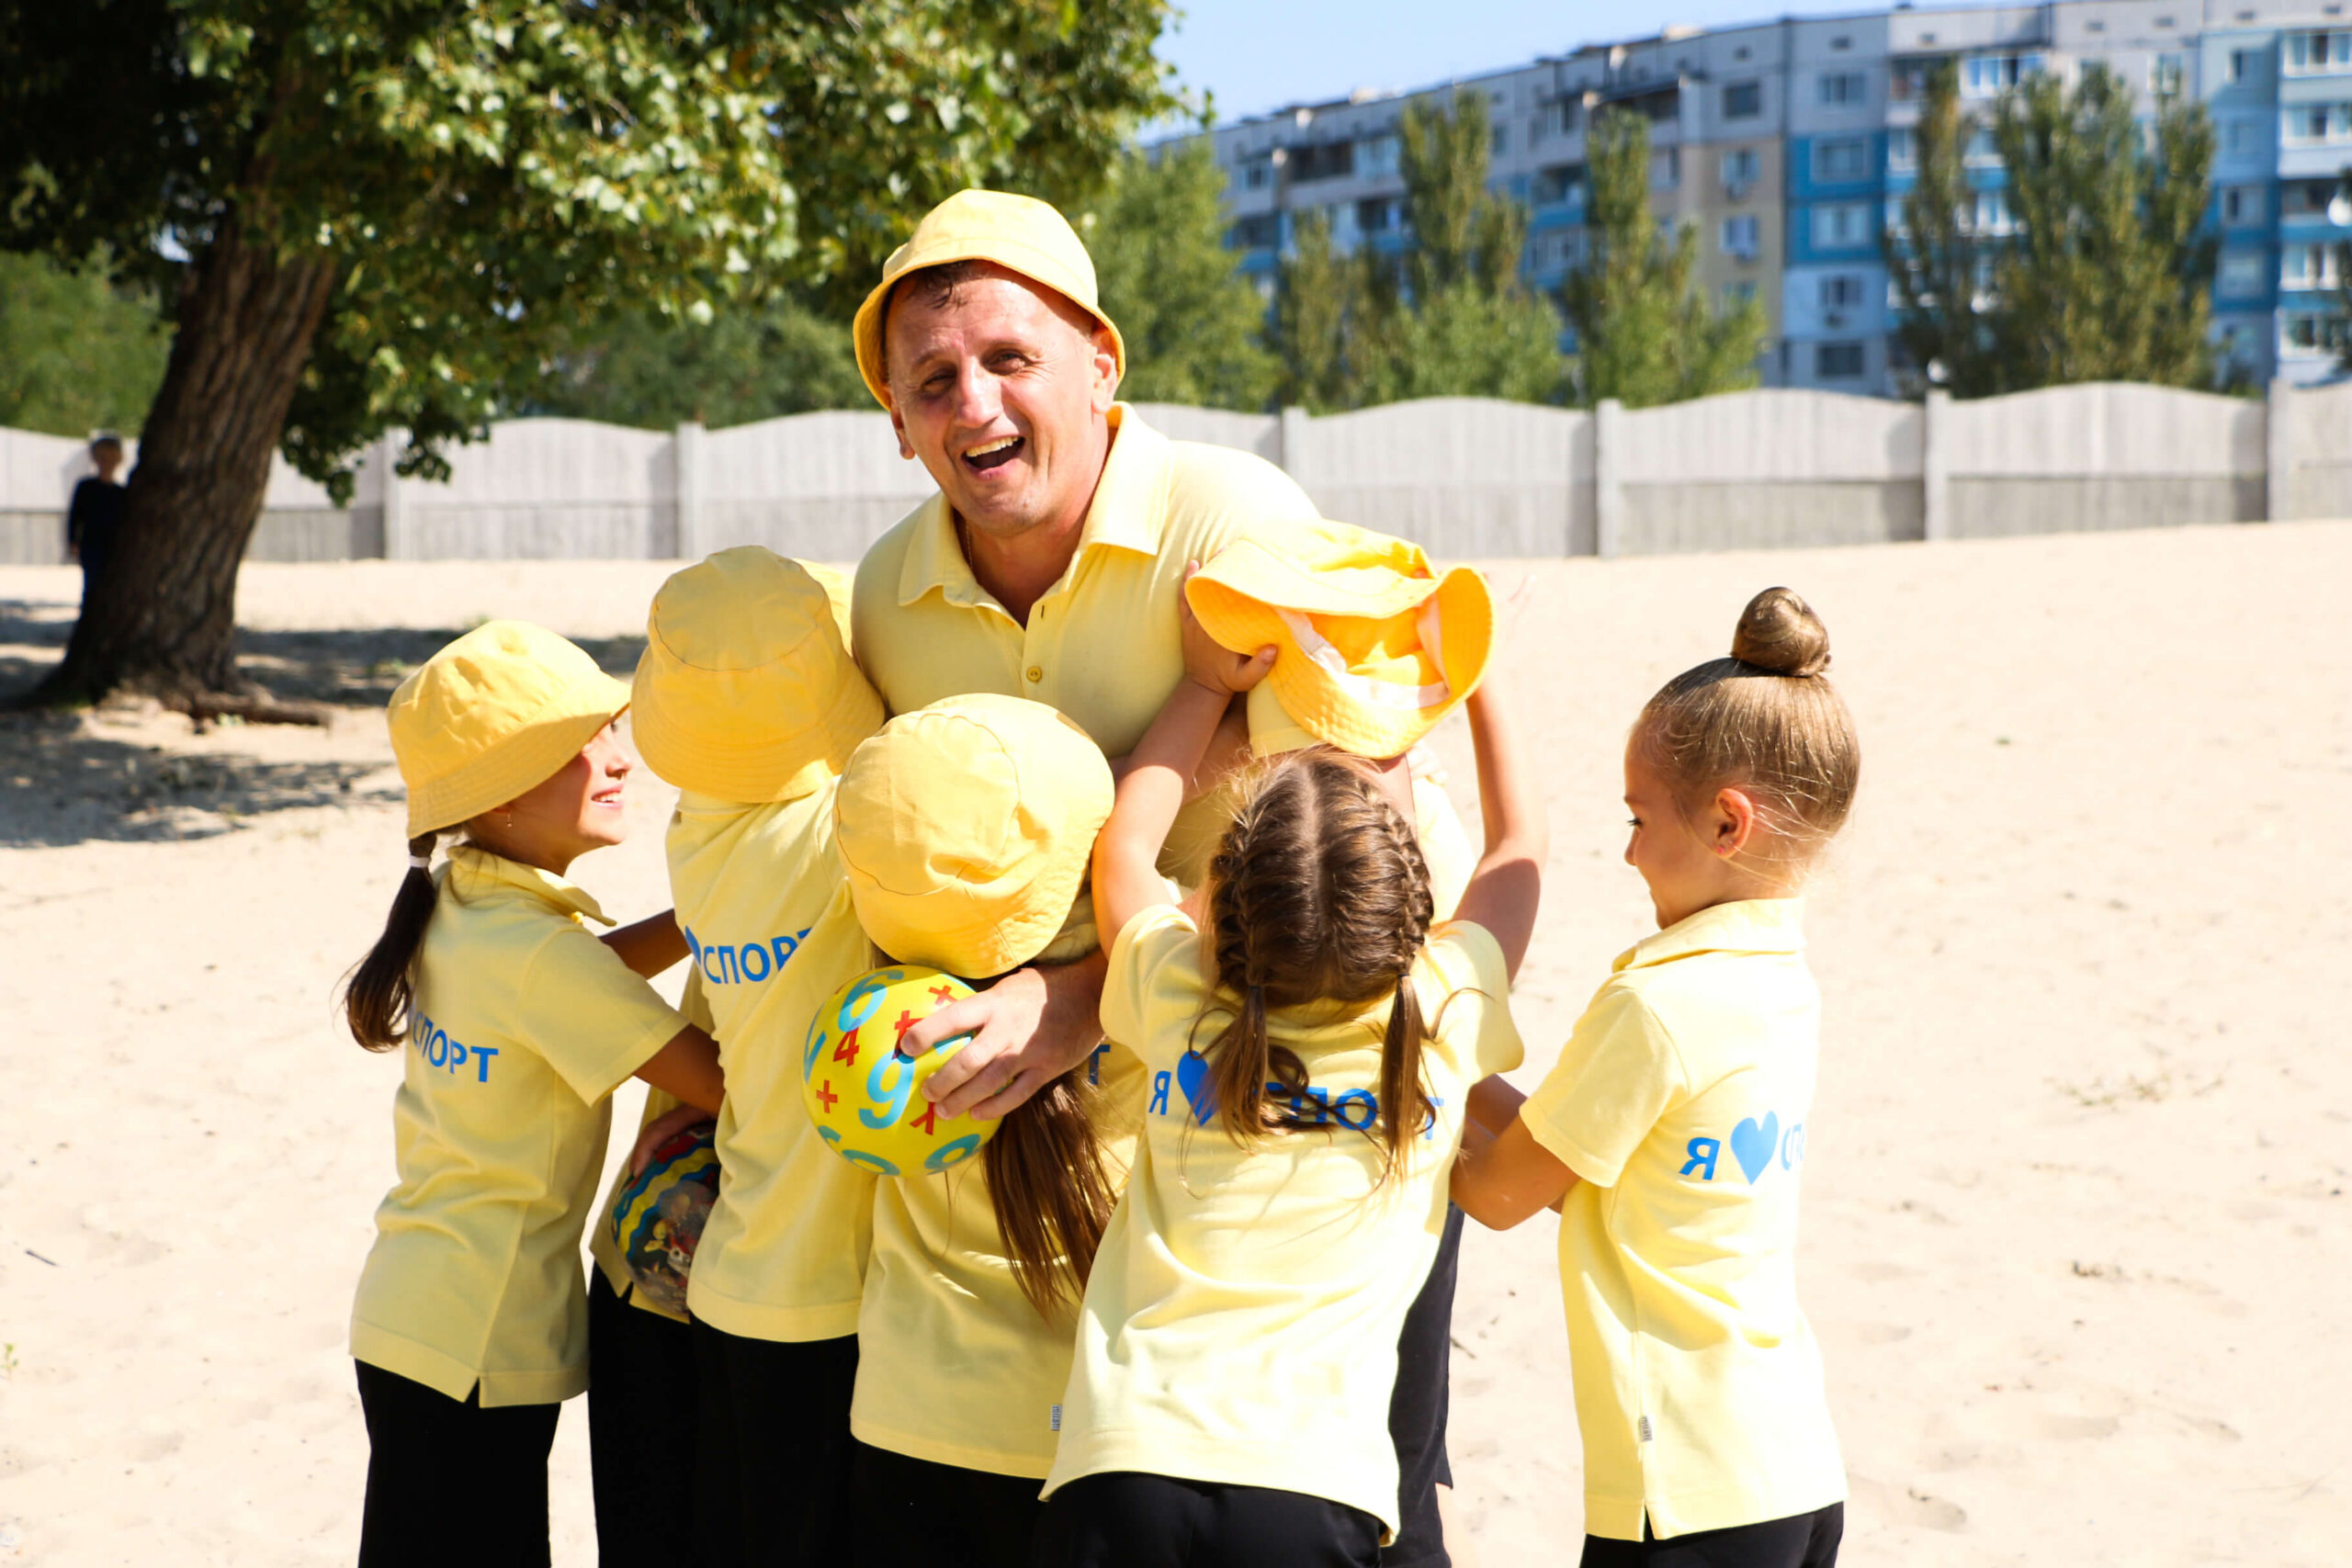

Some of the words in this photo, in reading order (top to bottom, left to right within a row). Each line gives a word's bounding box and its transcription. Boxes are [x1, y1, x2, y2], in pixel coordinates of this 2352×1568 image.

[838, 970, 905, 1032] 6
[832, 1018, 860, 1067] 4
[858, 1050, 915, 1130] 9
[1148, 1070, 1172, 1116] Я
[1679, 1137, 1721, 1180] Я
